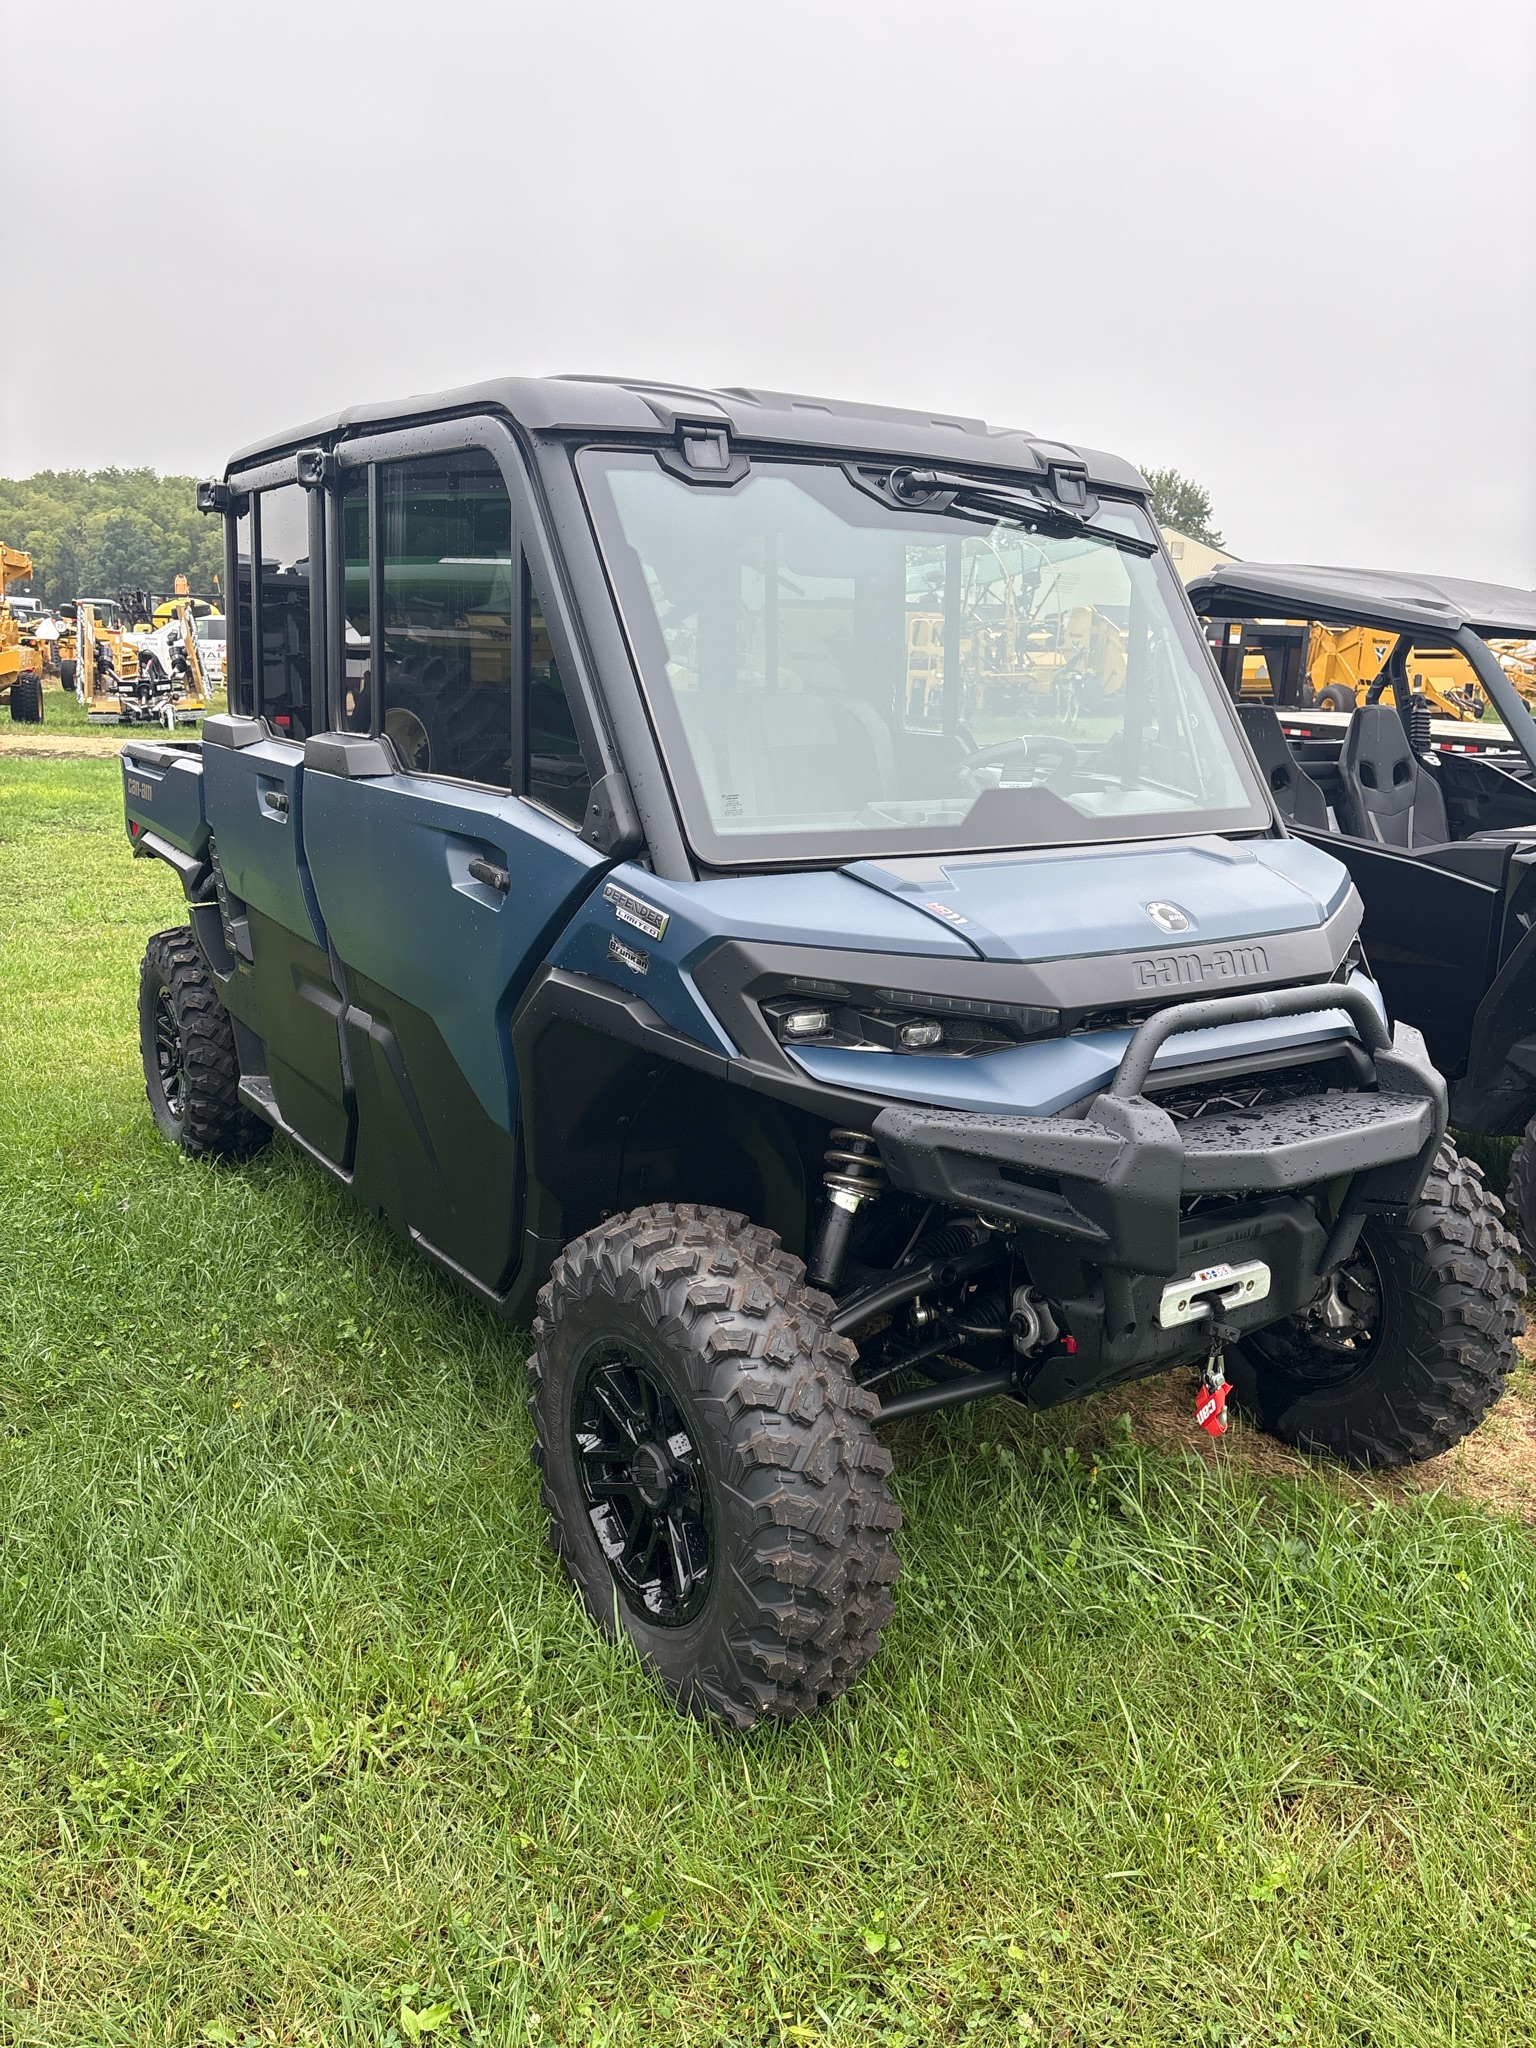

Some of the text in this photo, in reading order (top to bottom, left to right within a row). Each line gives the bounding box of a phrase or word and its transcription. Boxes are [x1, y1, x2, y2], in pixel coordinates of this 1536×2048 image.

[1371, 637, 1391, 645] Vermeer
[127, 778, 153, 801] can-am
[604, 887, 665, 926] DEFENDER
[610, 941, 648, 969] Brunkan
[1131, 946, 1270, 990] can-am
